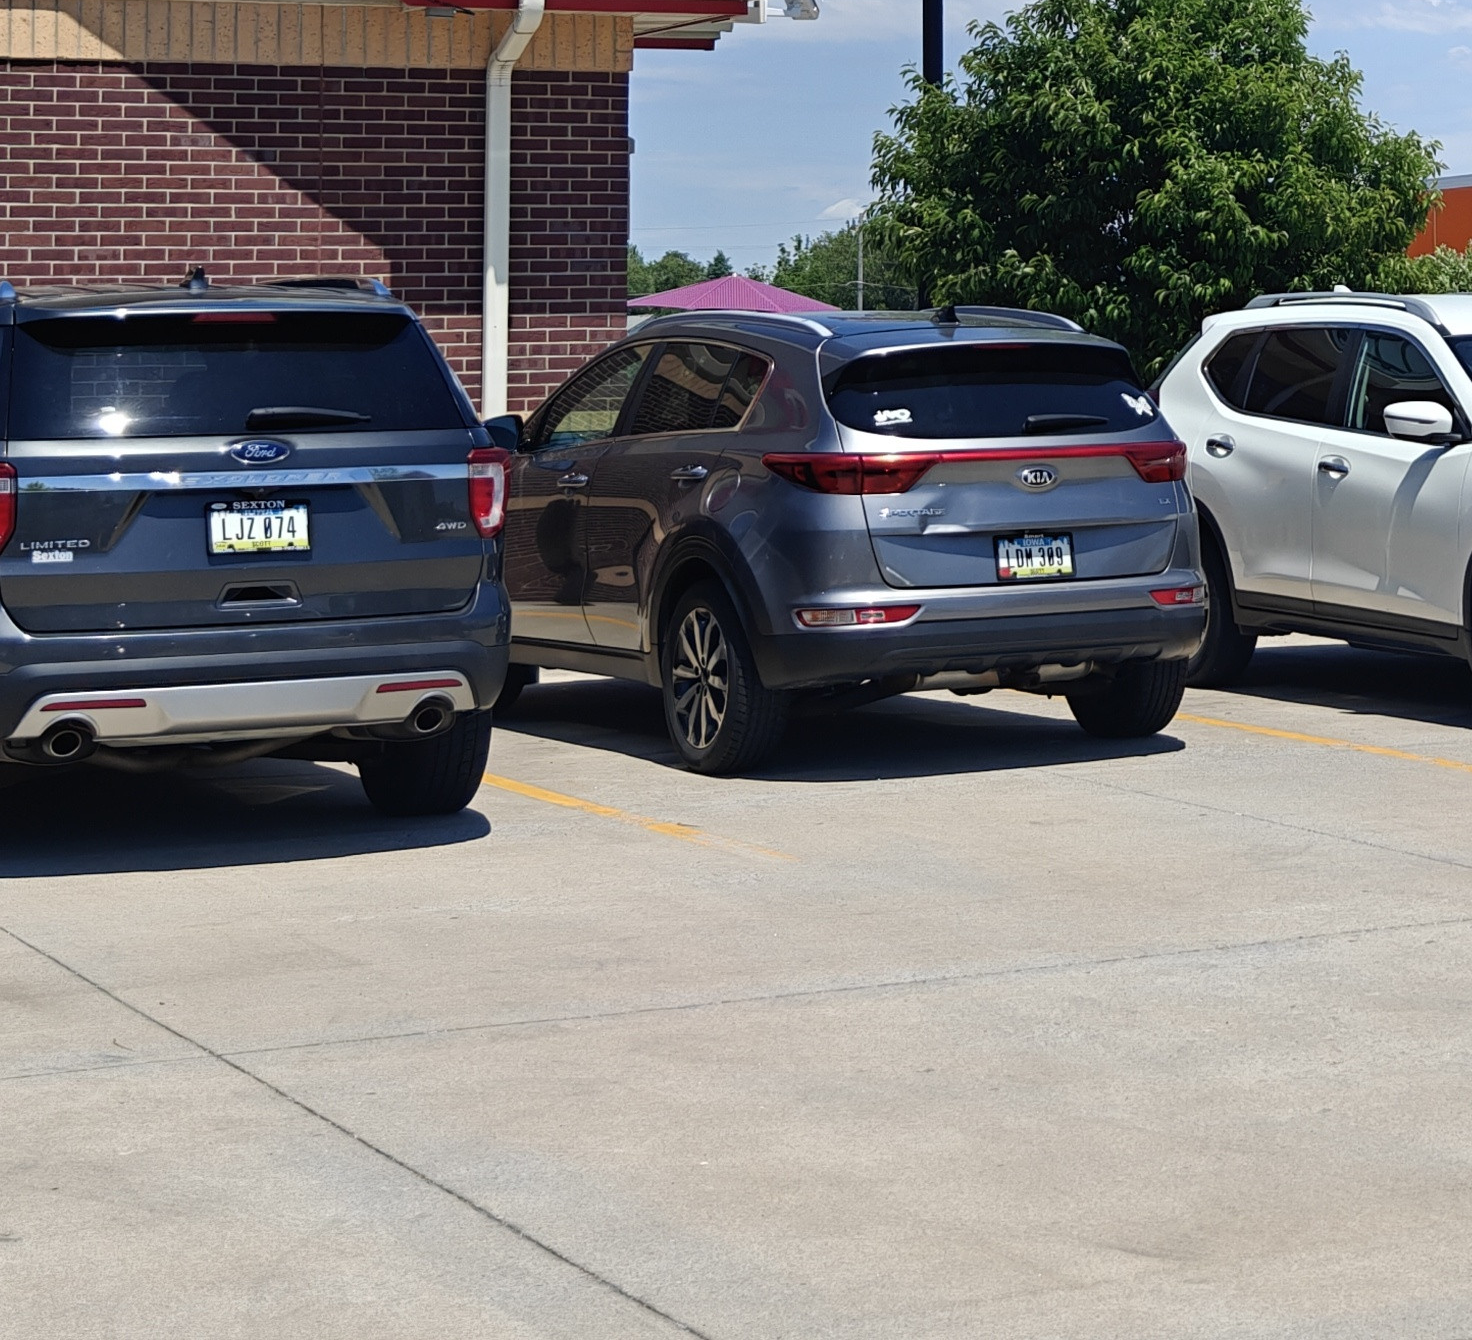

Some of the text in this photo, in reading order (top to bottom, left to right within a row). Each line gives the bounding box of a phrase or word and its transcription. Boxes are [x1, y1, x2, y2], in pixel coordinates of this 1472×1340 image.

[244, 444, 277, 458] Ford
[1028, 472, 1050, 483] KIA
[233, 500, 286, 510] SEXTON
[221, 516, 297, 540] LJZ 074
[20, 539, 91, 550] LIMITED
[1023, 538, 1045, 546] IOWA
[31, 550, 73, 563] Sexton
[1006, 546, 1064, 568] LDM 309
